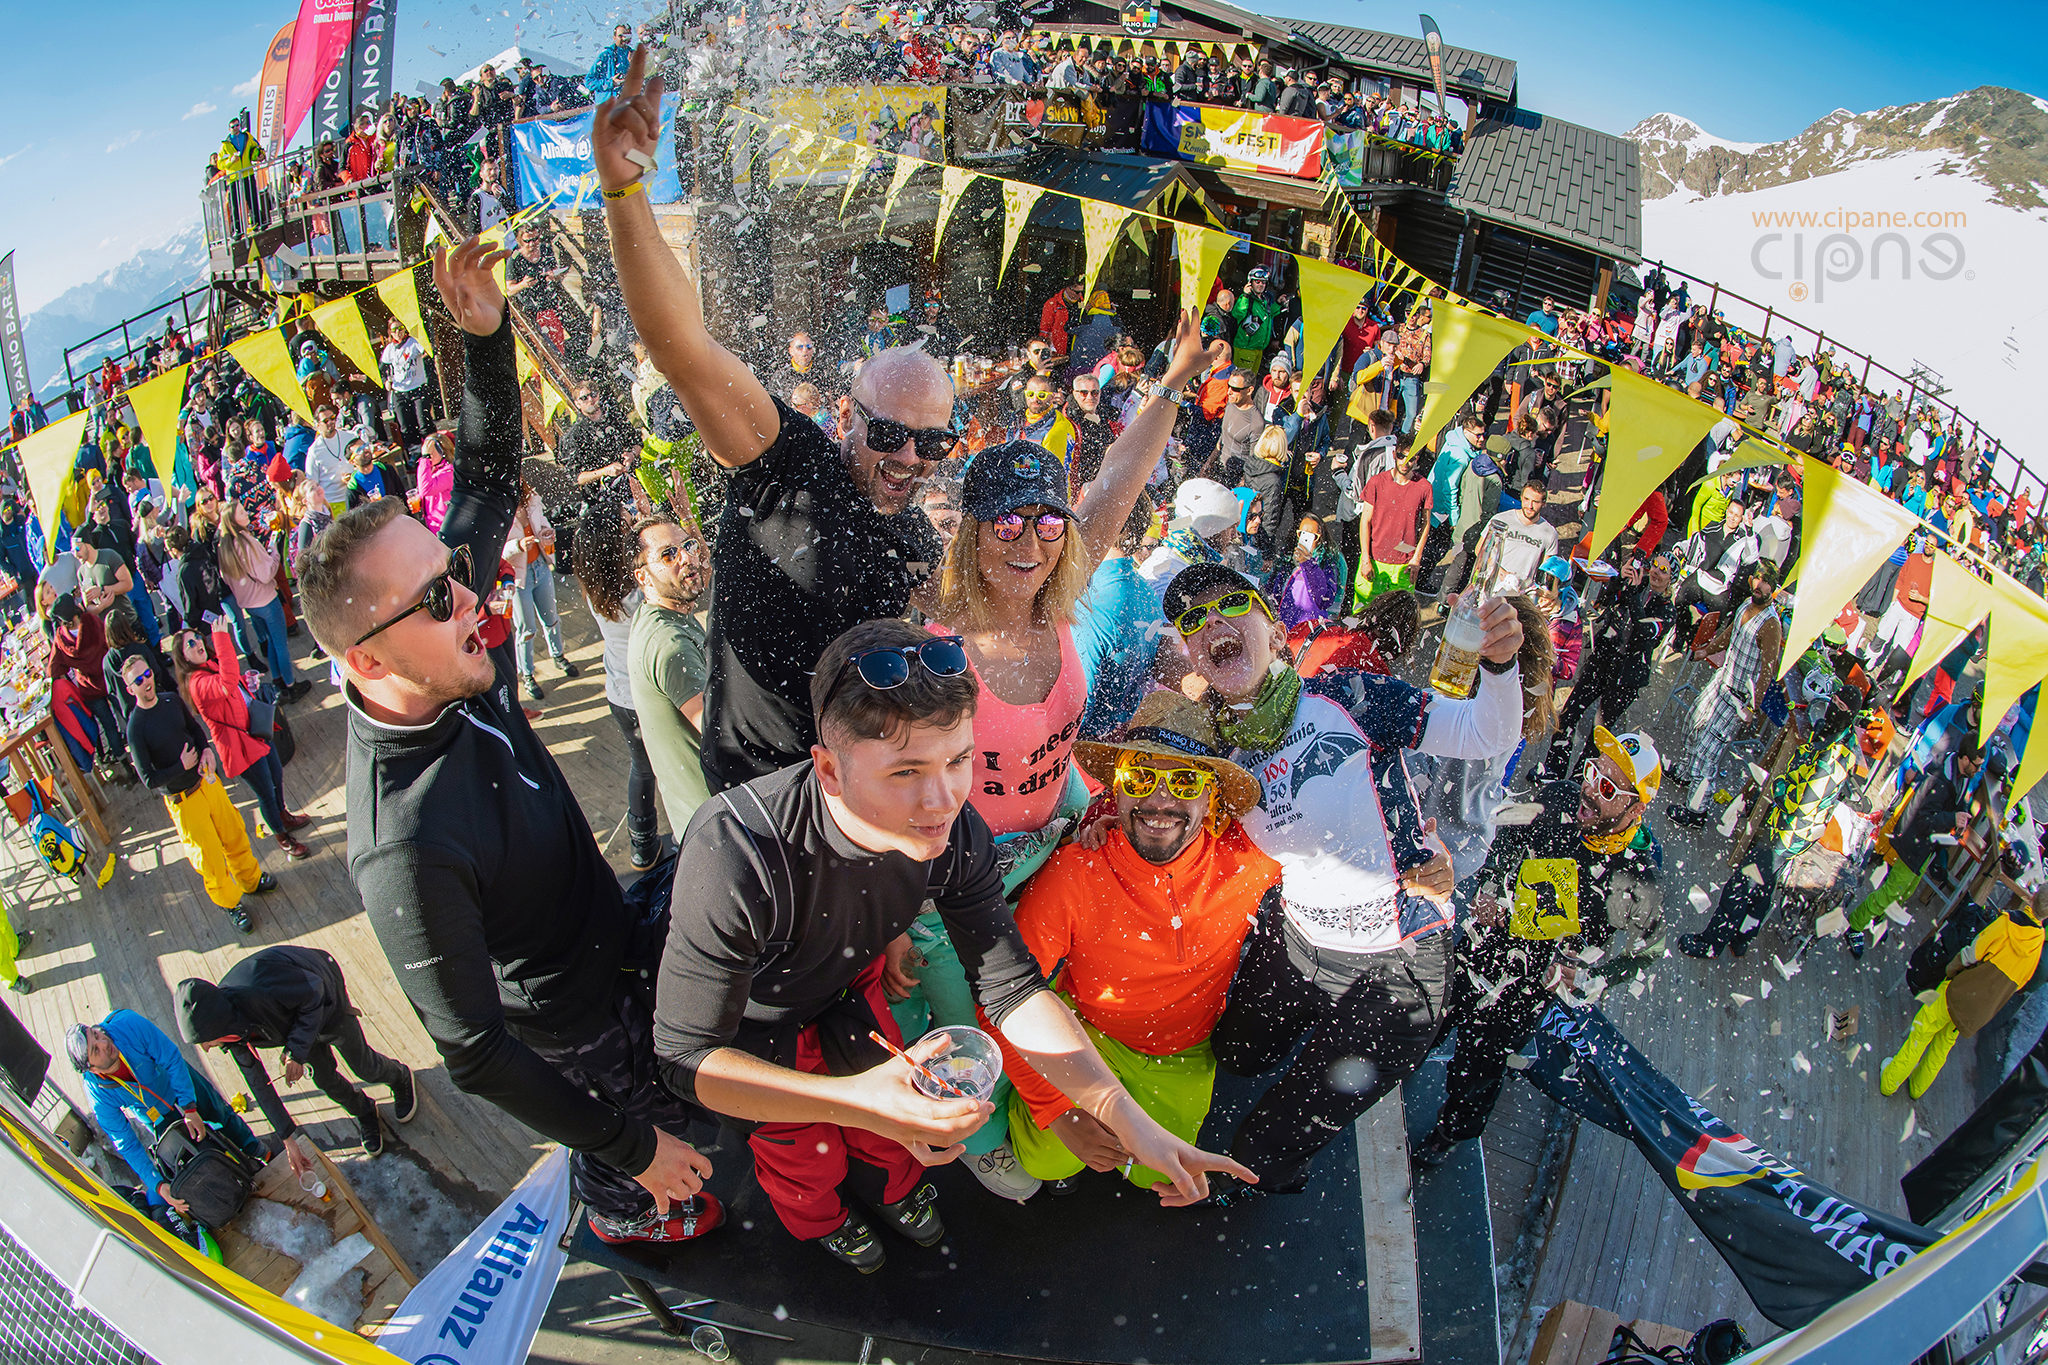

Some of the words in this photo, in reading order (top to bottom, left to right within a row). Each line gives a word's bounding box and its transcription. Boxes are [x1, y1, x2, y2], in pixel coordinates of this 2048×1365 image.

[262, 88, 275, 138] PRINS
[1005, 101, 1028, 122] BT
[1237, 132, 1277, 150] FEST
[2, 294, 17, 335] BAR
[9, 340, 26, 393] PANO
[1158, 730, 1187, 746] PANO
[1189, 740, 1208, 756] BAR
[982, 751, 1002, 771] I
[1262, 757, 1289, 783] 100
[983, 781, 1006, 796] a
[1269, 781, 1287, 804] 50
[1269, 802, 1293, 819] ultra
[1544, 862, 1575, 900] KANGAROOS
[1561, 867, 1572, 880] NO
[1517, 908, 1536, 937] AUSTRIA
[438, 1202, 549, 1350] Allianz
